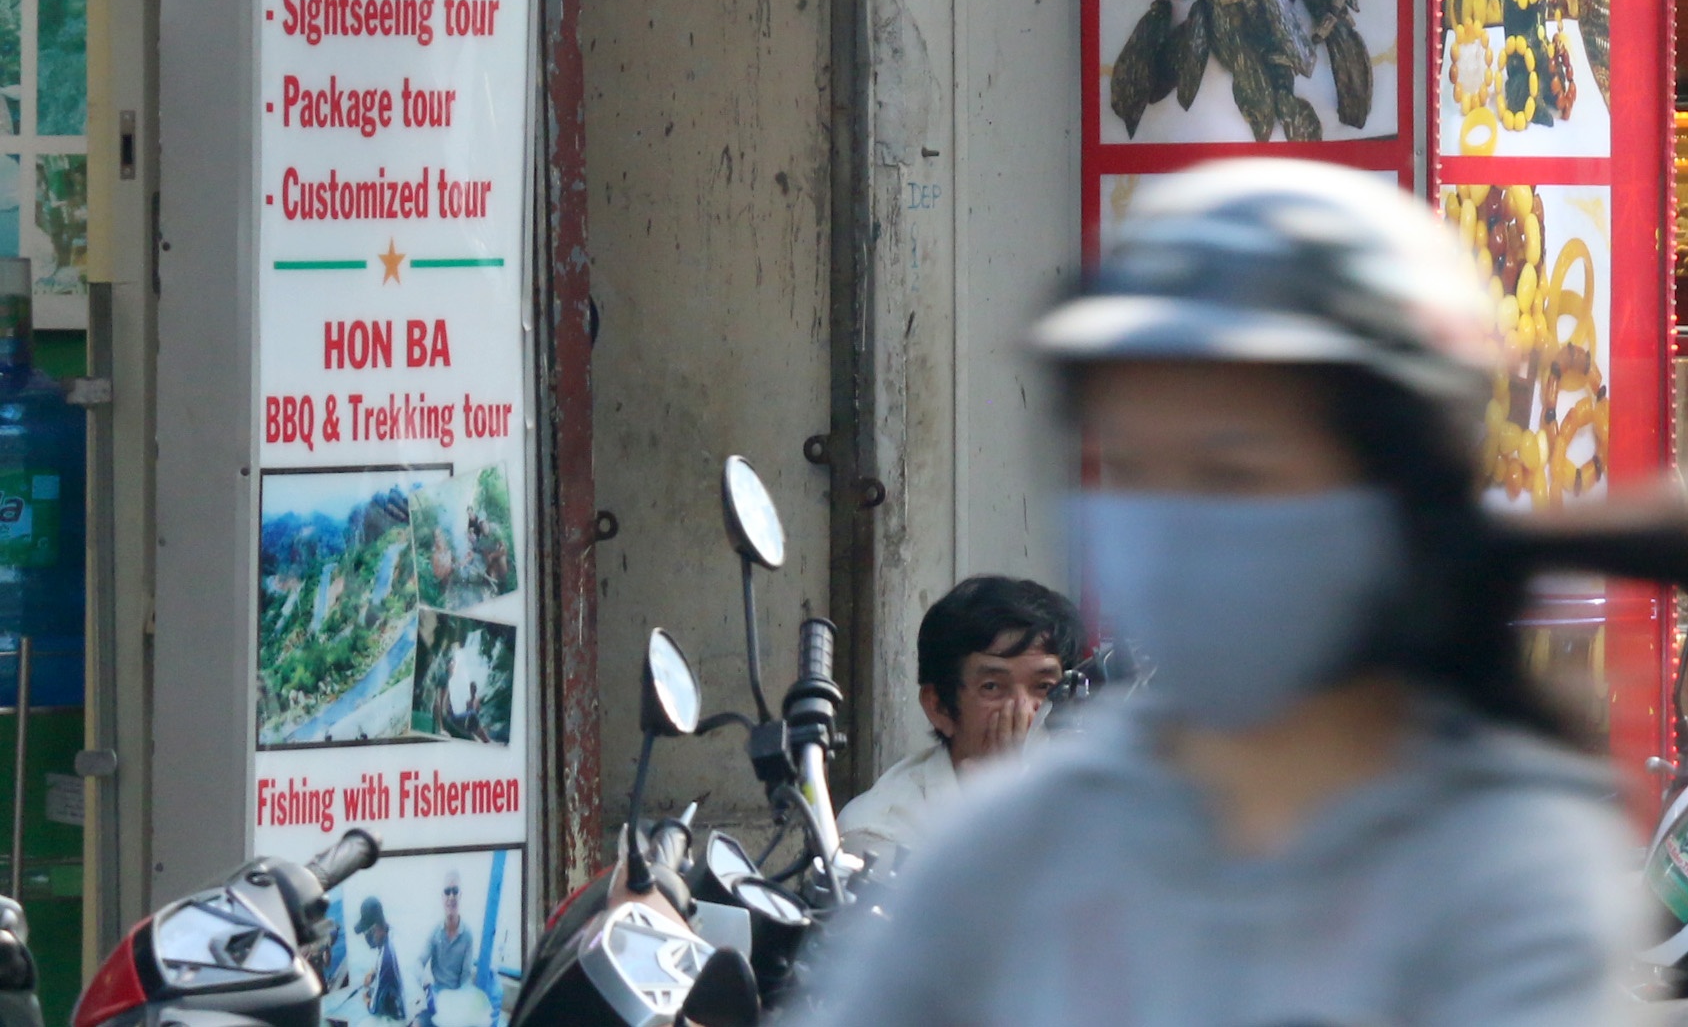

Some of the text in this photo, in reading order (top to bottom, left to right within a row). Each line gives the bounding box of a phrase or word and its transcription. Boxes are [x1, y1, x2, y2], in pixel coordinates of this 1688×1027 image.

[283, 75, 456, 138] Package tour
[282, 167, 491, 221] Customized tour
[323, 319, 451, 370] HON BA
[265, 394, 512, 451] BBQ & Trekking tour
[256, 770, 519, 831] Fishing with Fishermen
